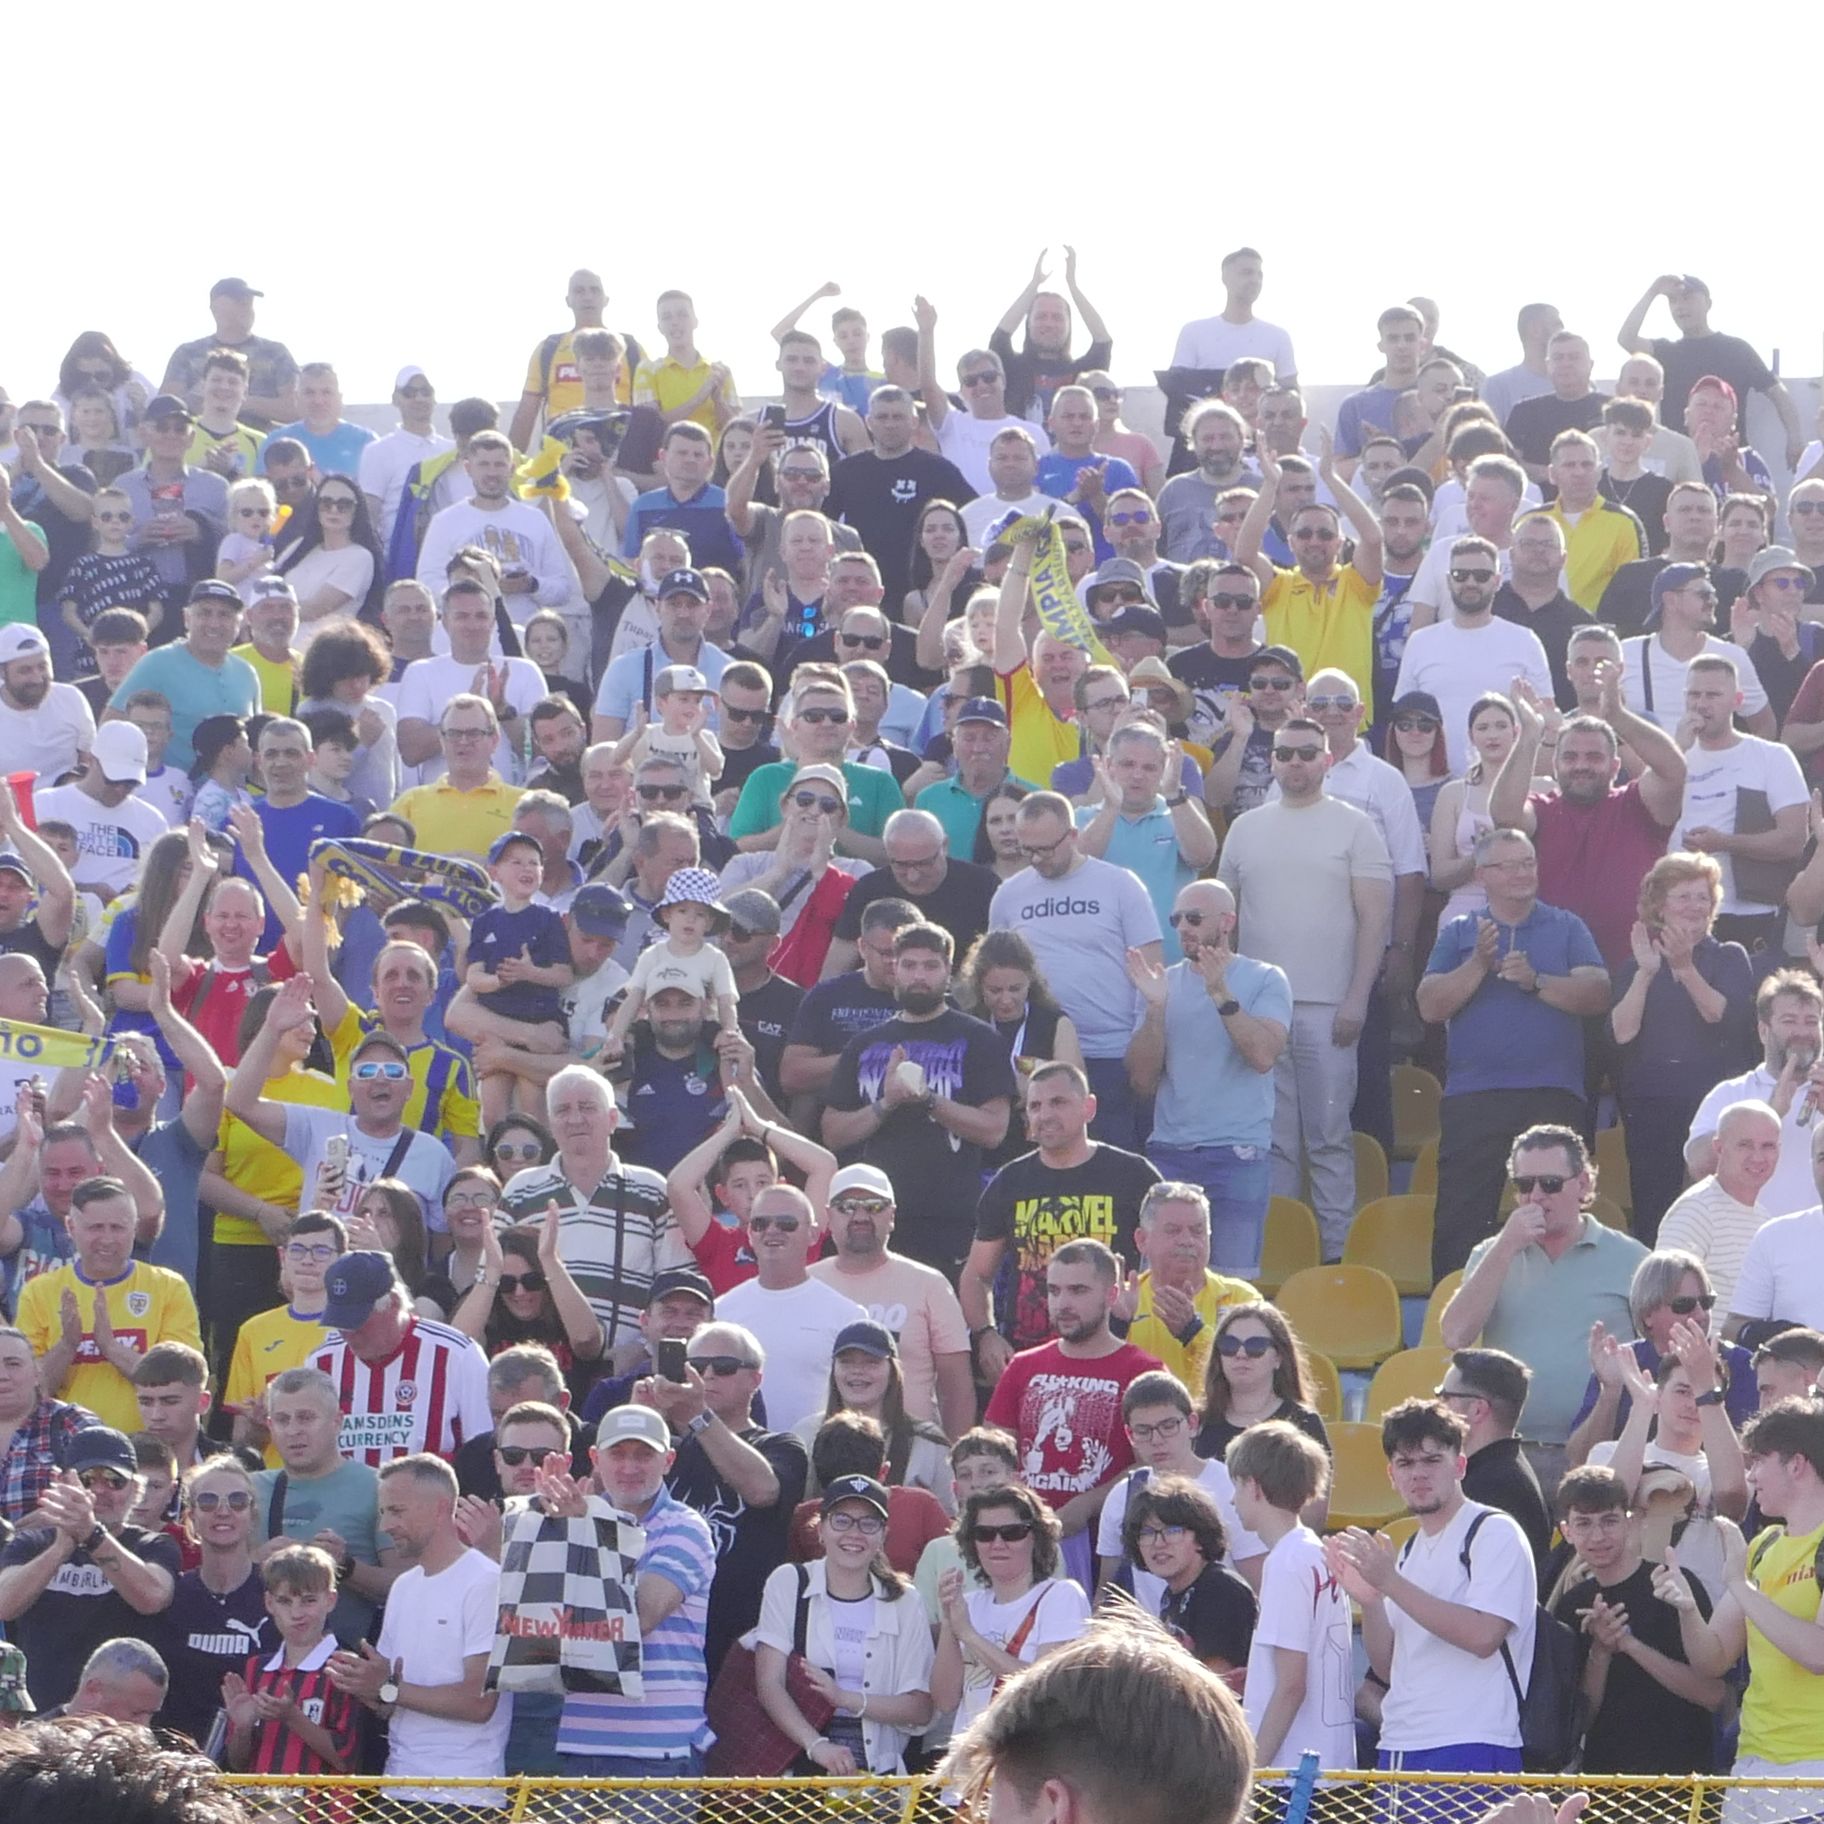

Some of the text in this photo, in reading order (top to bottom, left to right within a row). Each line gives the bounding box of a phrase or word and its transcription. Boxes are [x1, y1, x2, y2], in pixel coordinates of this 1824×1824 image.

[89, 821, 118, 836] THE
[76, 831, 118, 845] ORTH
[1020, 896, 1101, 921] adidas
[342, 1414, 415, 1432] AMSDENS
[337, 1431, 411, 1449] CURRENCY
[188, 1633, 250, 1655] PUMA
